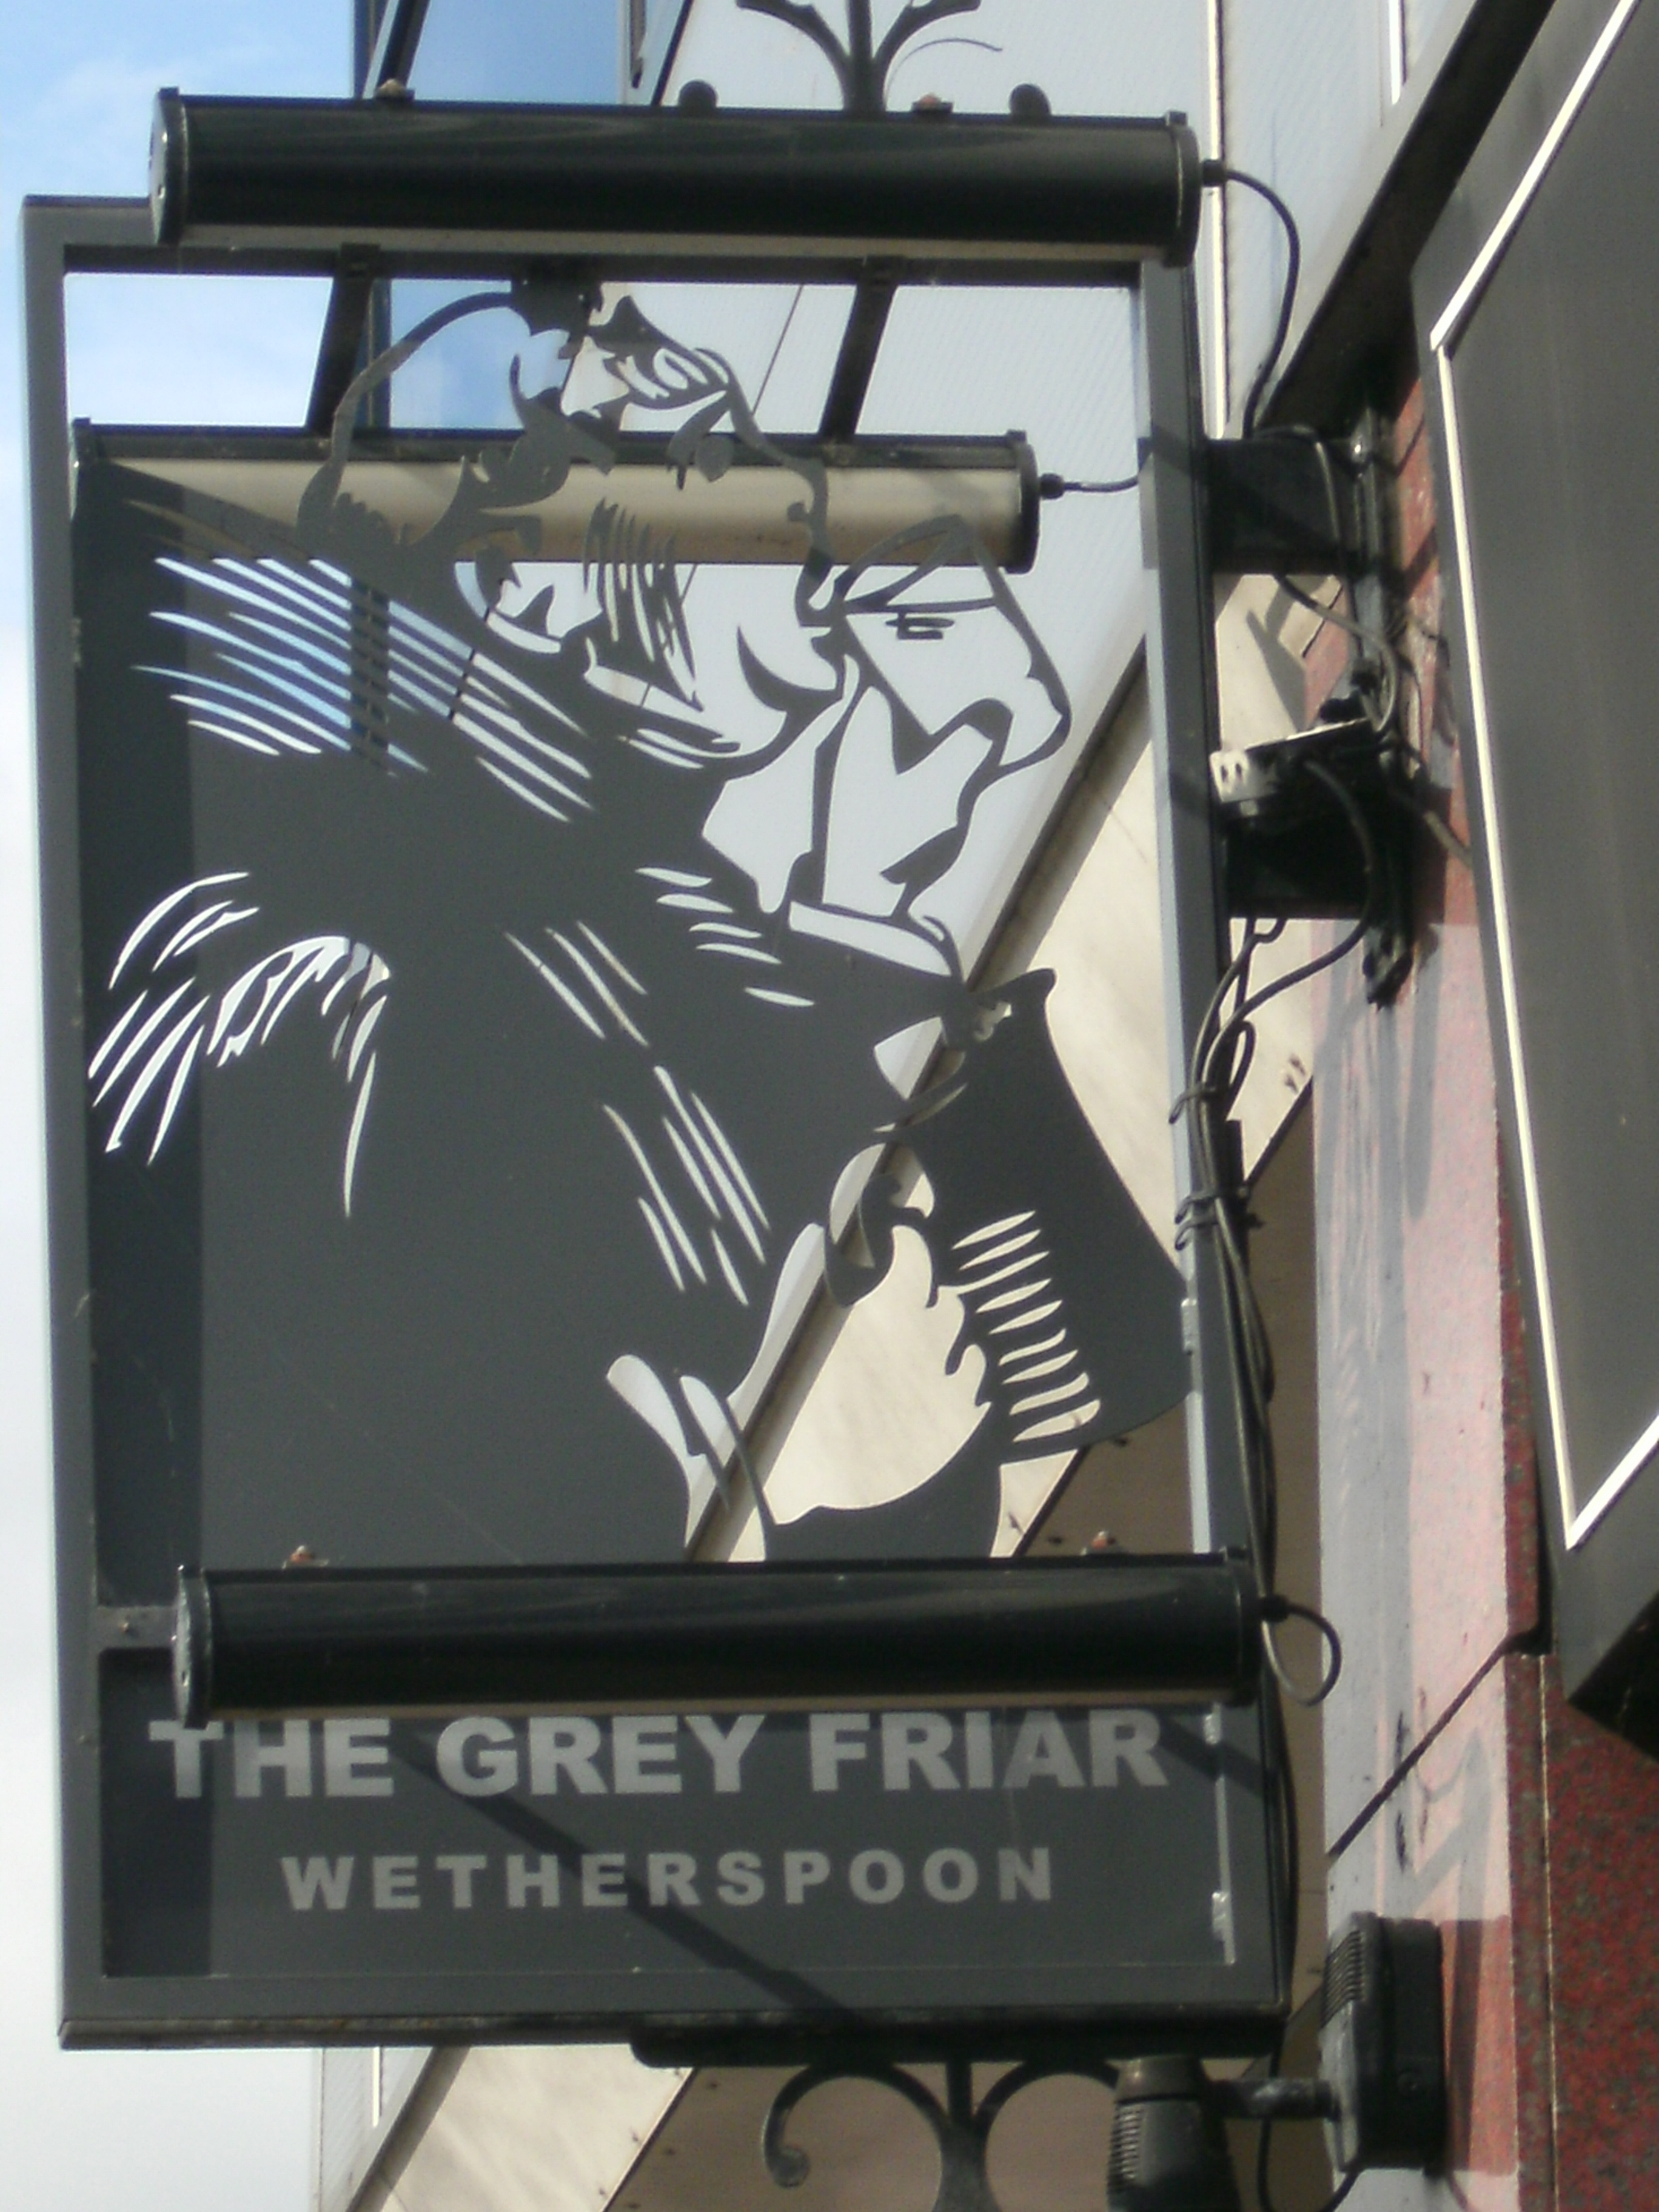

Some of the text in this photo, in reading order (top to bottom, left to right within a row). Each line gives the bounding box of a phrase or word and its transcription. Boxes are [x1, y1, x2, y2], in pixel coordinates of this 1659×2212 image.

[149, 1710, 1168, 1799] THE GREY FRIAR
[281, 1848, 1053, 1910] WETHERSPOON
